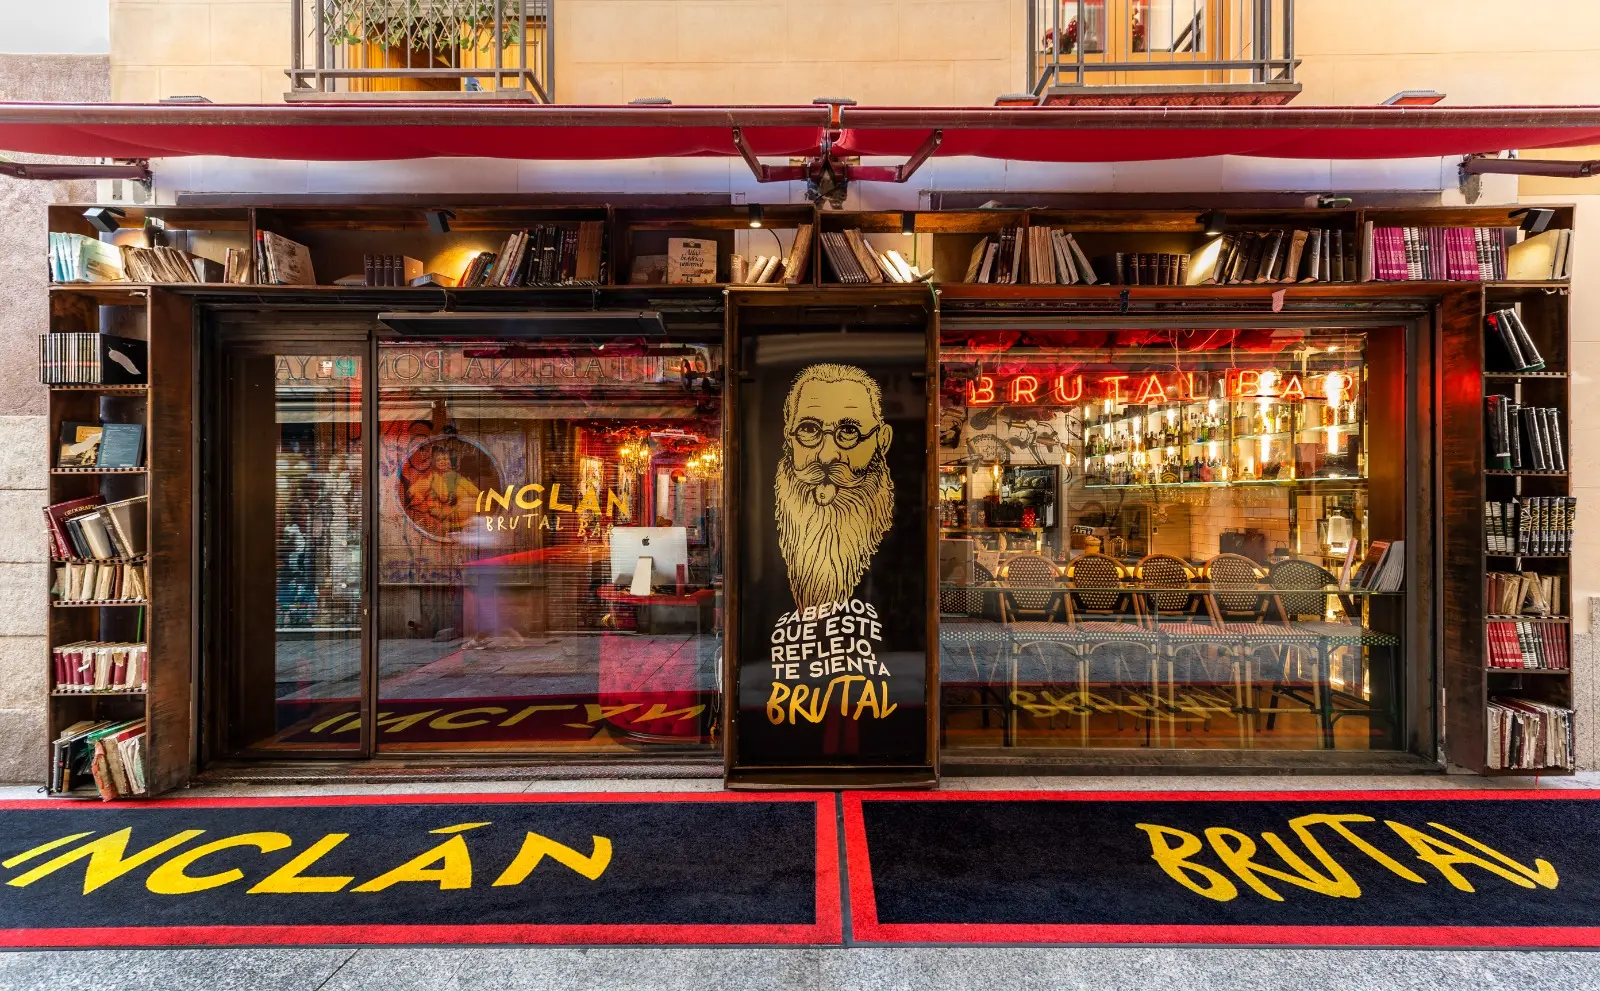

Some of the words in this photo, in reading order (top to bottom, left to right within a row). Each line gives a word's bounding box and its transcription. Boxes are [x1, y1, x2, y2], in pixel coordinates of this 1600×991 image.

[968, 372, 1208, 404] BRUTAL
[1238, 370, 1354, 401] BAR
[485, 513, 564, 532] BRUTAL
[577, 517, 614, 538] BAR
[774, 598, 878, 628] SABEMOS
[770, 622, 818, 644] QUE
[826, 616, 883, 642] ESTE
[771, 636, 876, 662] REFLEJO,
[771, 663, 800, 680] TE
[809, 655, 891, 678] SIENTA
[766, 674, 898, 725] BRUTAL
[2, 821, 613, 895] INCLÁN
[1135, 813, 1559, 902] BRUTAL
